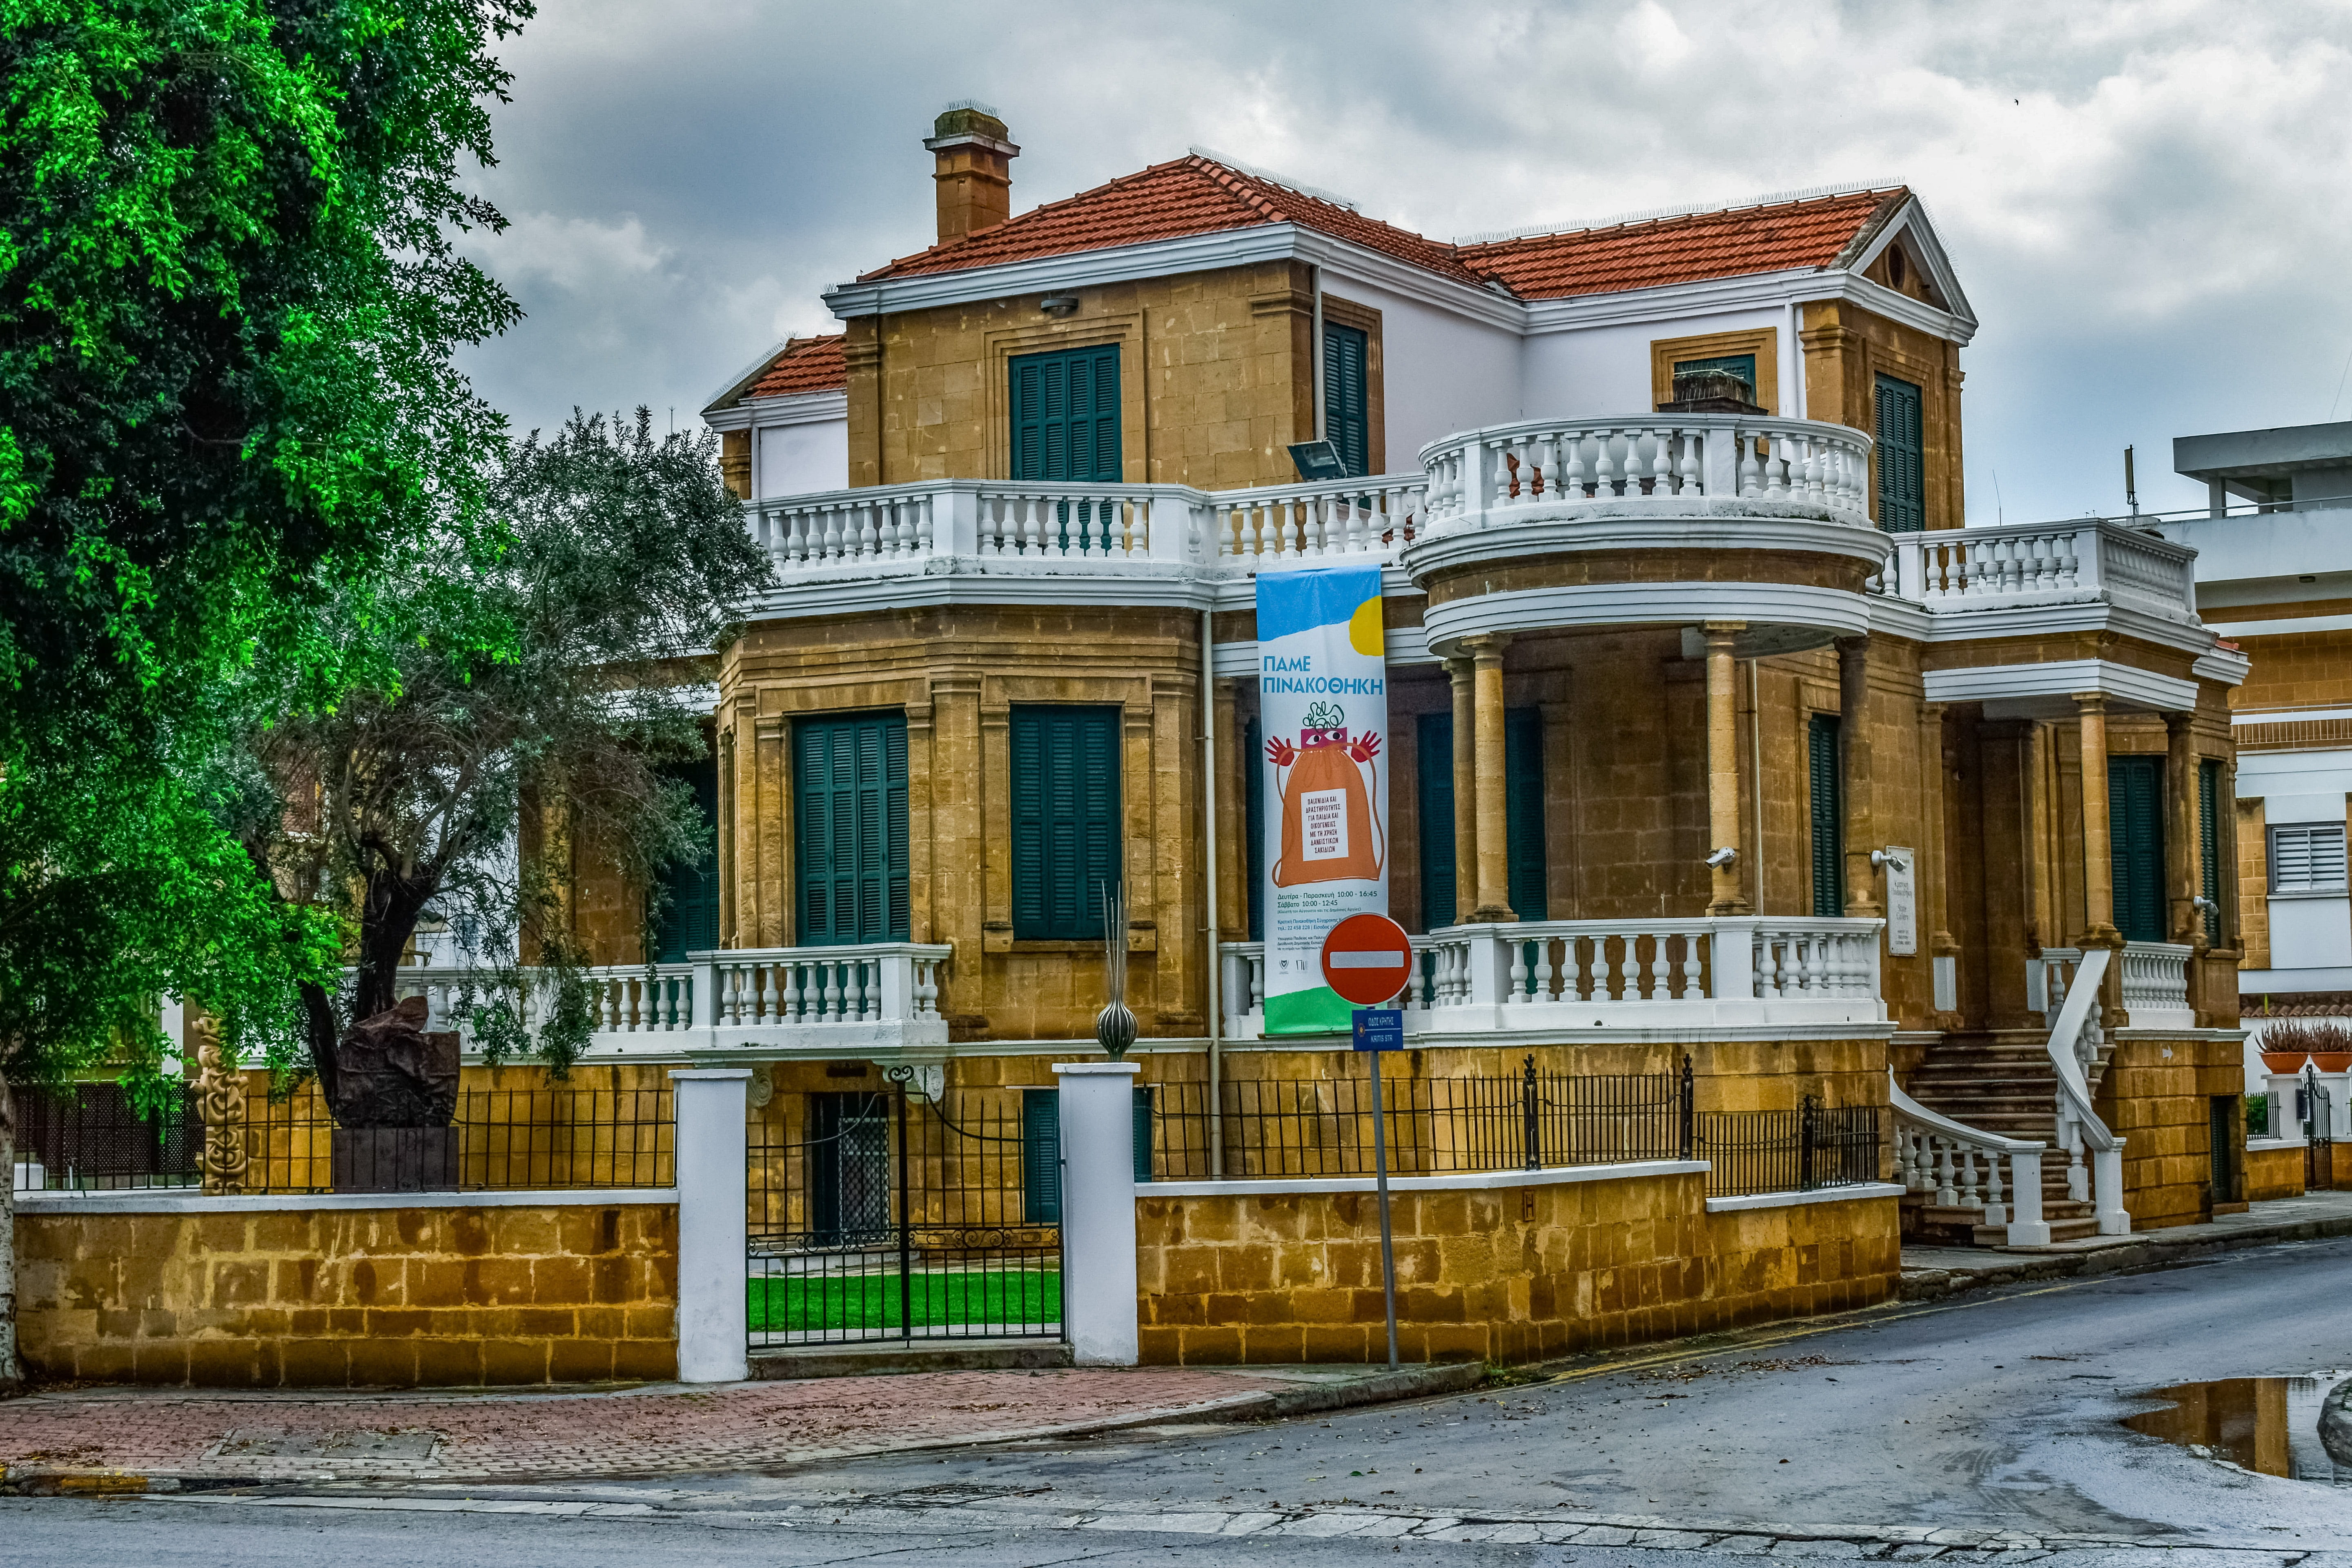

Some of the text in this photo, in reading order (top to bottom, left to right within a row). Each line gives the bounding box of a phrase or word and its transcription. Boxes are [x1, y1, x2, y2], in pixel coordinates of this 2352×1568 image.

[1263, 656, 1310, 672] ΠΑΜΕ
[1263, 677, 1383, 695] ΠΙΝΑΚΟΘΗΚΗ
[1307, 796, 1329, 805] ΠΑΙΧΝΙΔΙΑ
[1306, 804, 1341, 813] ΔΡΑΣΤΗΡΙΟΤΗΤΕΣ
[1311, 821, 1336, 829] ΟΙΚΟΓΕΝΕΙΕΣ
[1311, 837, 1339, 845] ΔΑΝΕΙΣΤΙΚΩΝ
[1368, 1016, 1394, 1026] ΟΔΟΣ ΚΡΗΤΗΣ
